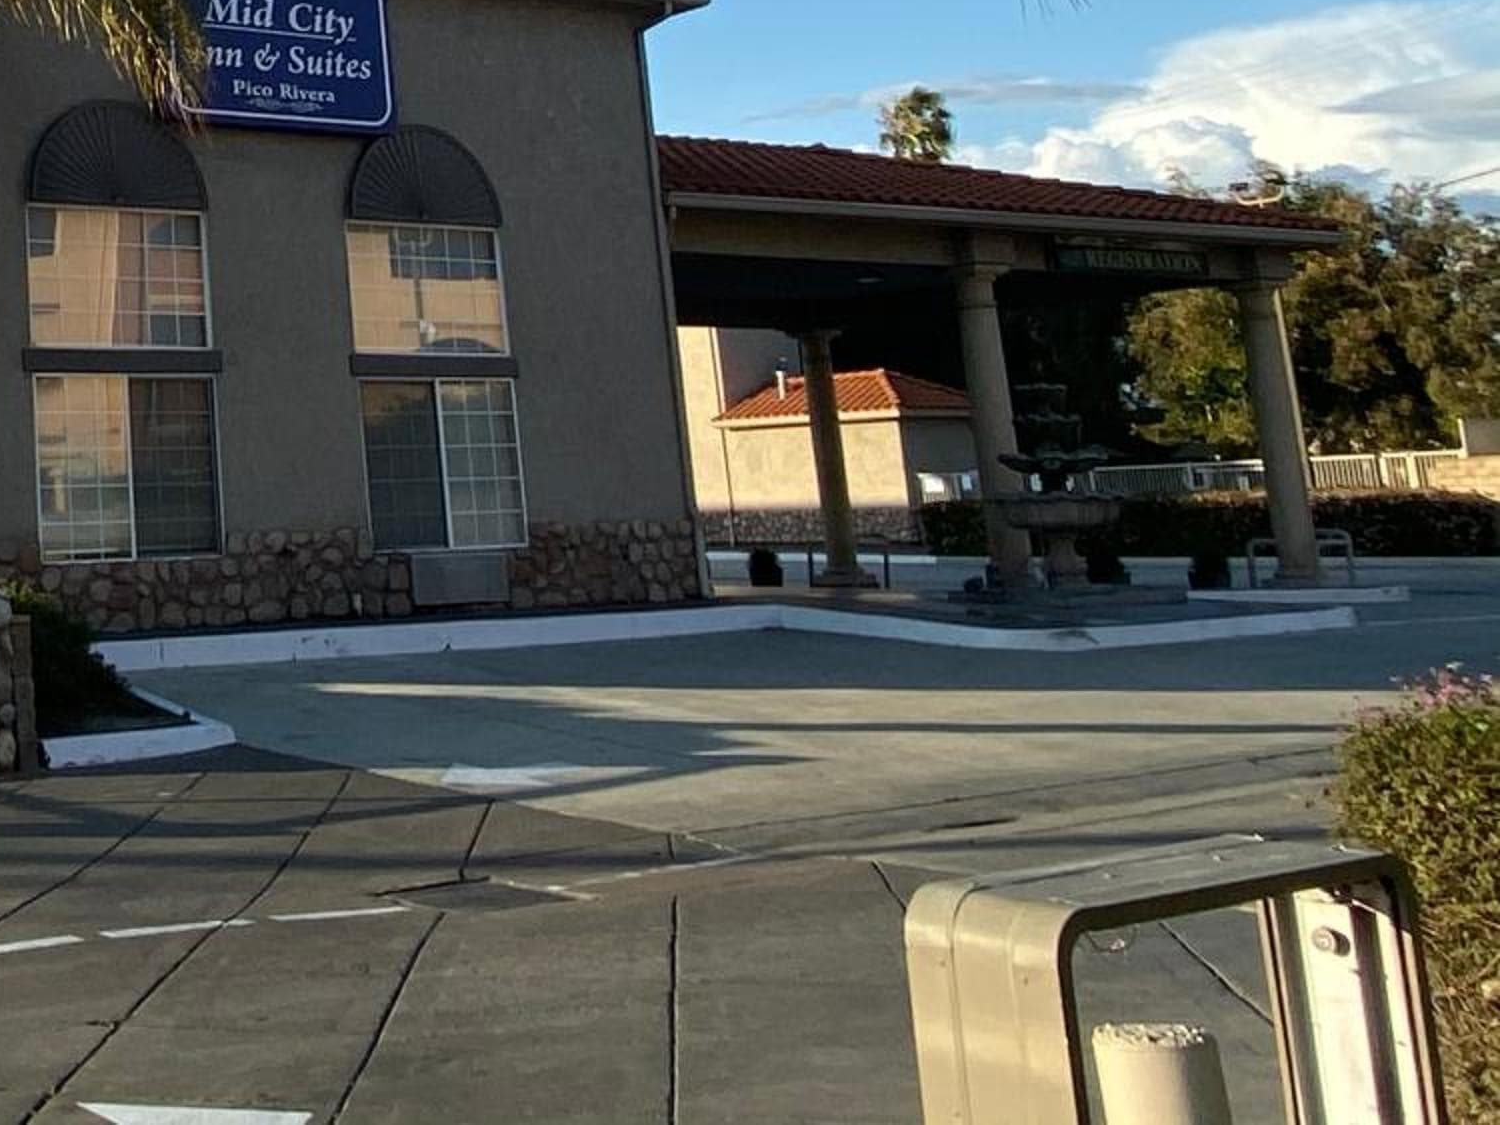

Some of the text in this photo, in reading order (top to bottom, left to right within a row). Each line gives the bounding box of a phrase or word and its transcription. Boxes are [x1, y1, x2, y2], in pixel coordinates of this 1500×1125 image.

[288, 2, 354, 45] City
[205, 43, 372, 80] nn & Suites
[232, 79, 336, 103] Pico Rivera
